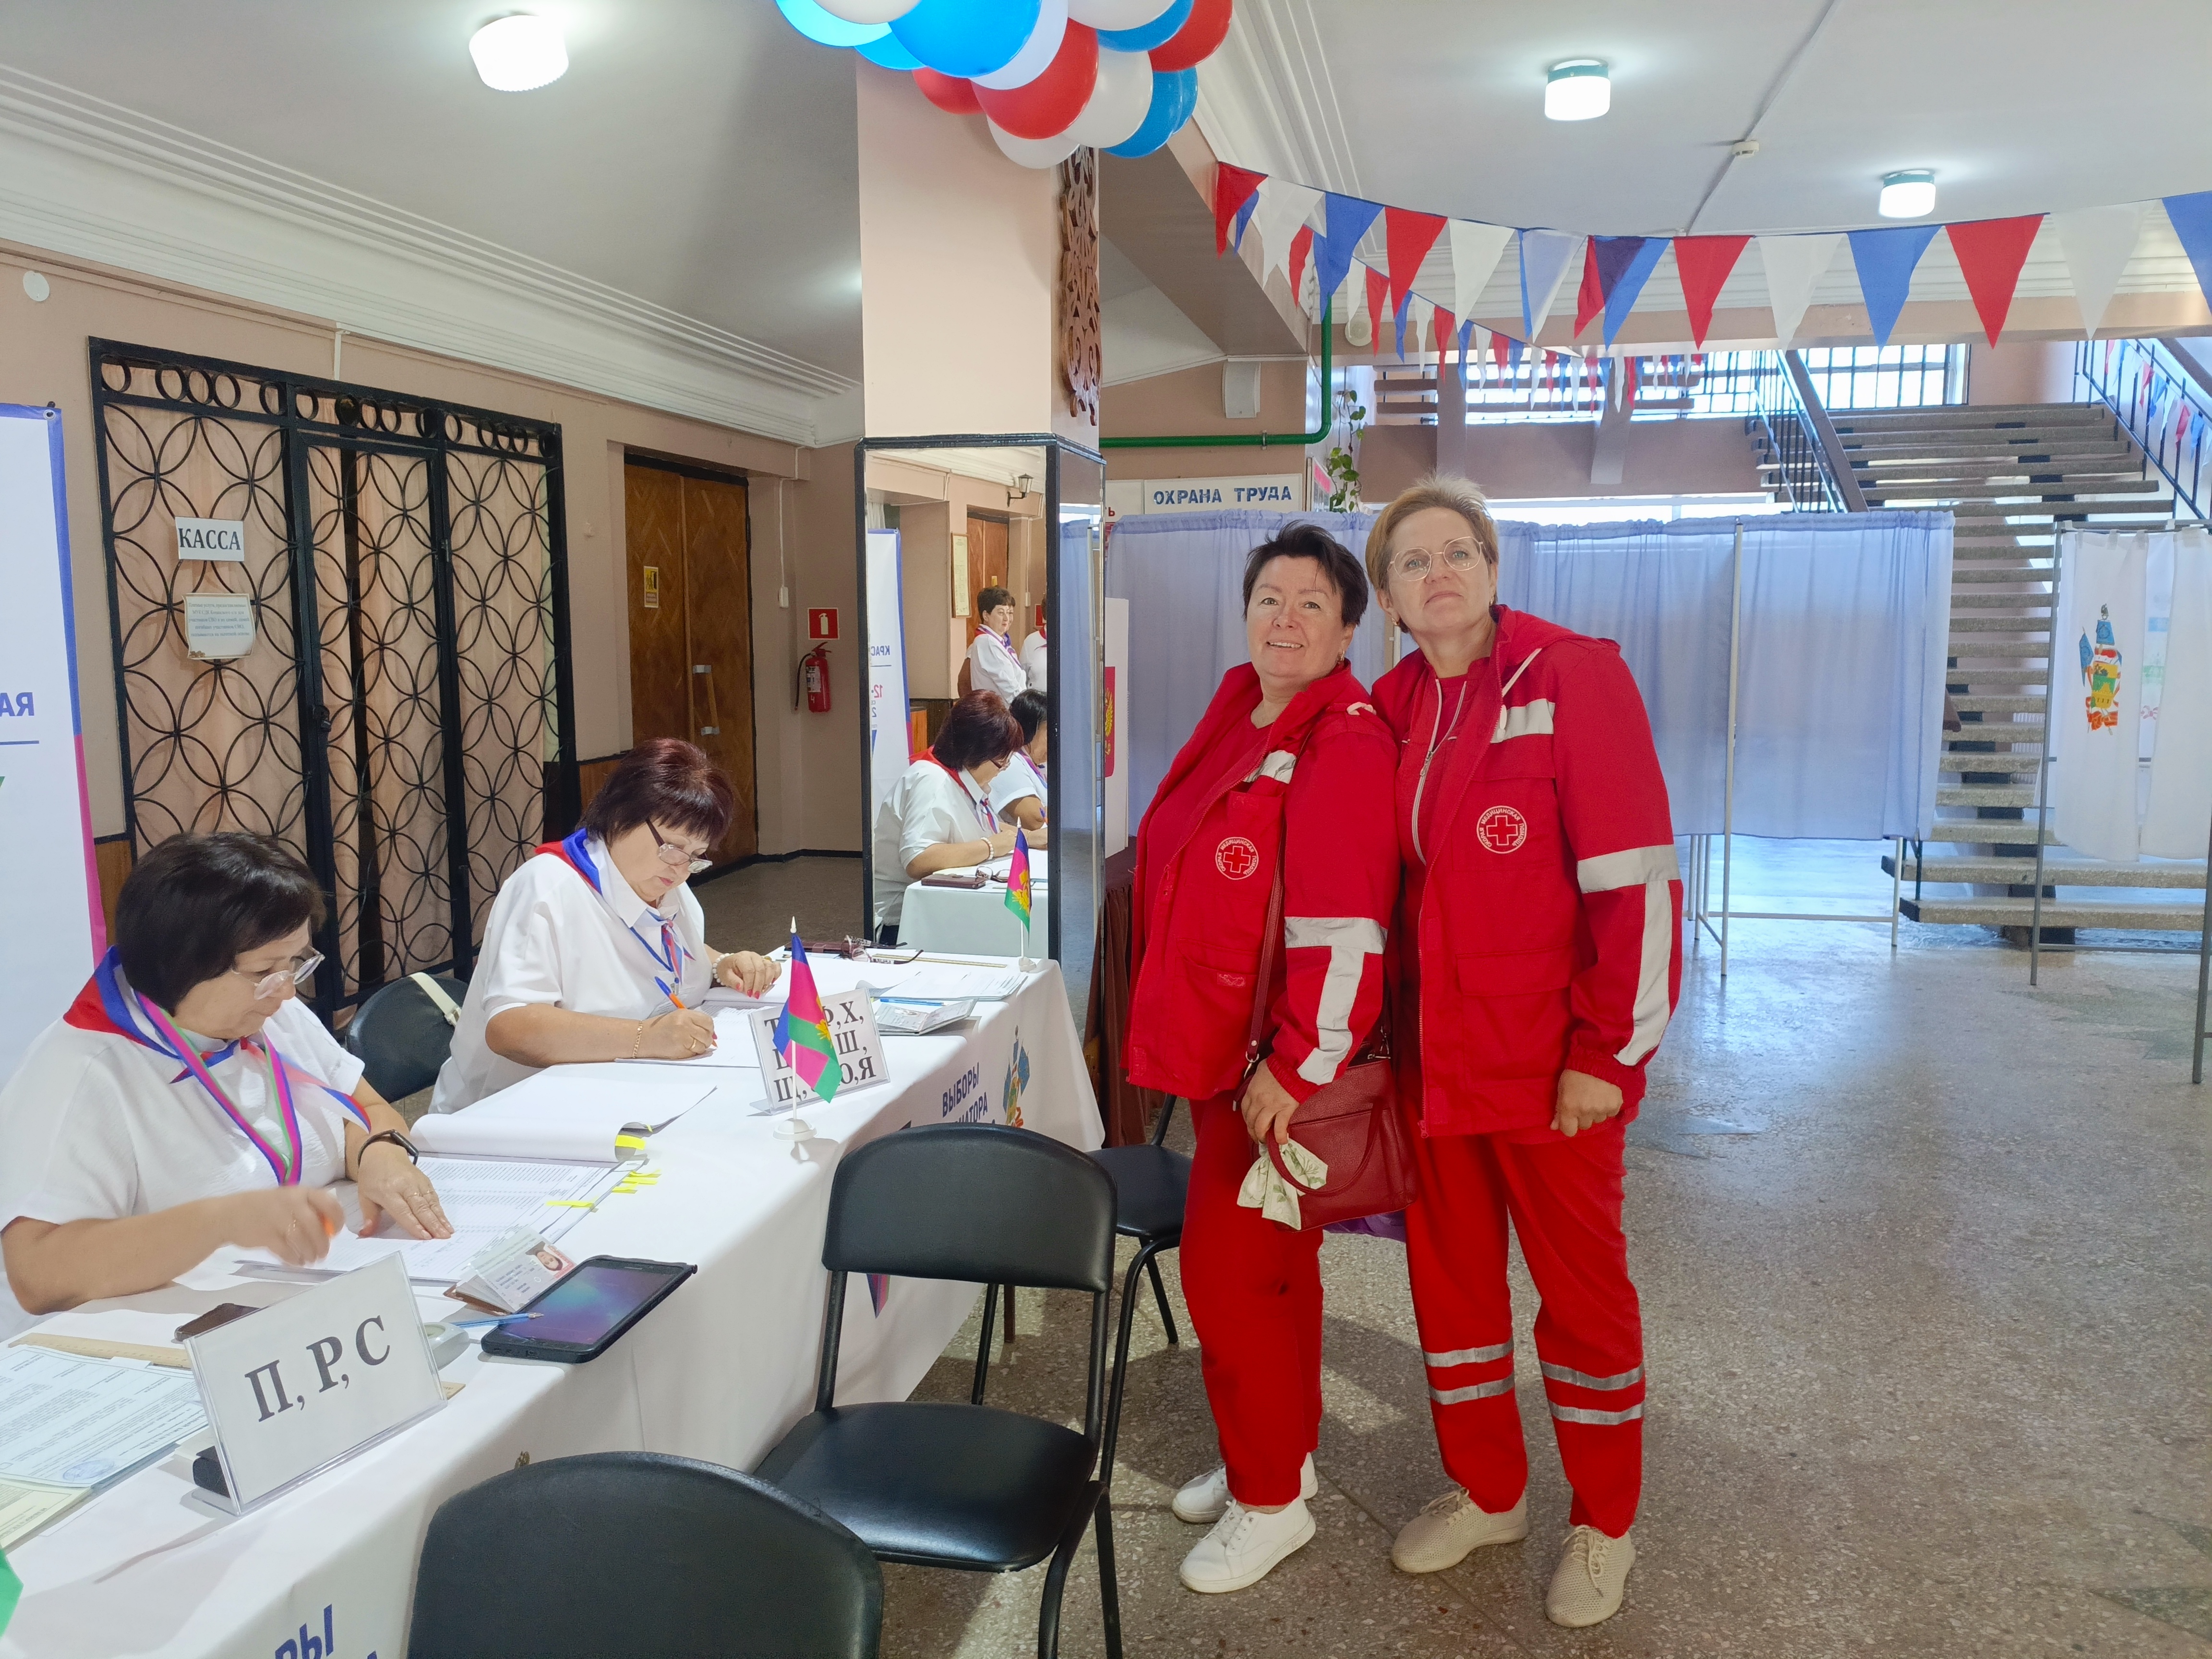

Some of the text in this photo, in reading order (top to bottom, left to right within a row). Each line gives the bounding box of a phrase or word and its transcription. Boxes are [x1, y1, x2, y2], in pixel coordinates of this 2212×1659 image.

[1153, 486, 1292, 505] ОХРАНА ТРУДА
[1105, 506, 1116, 517] Ь
[178, 528, 241, 551] КАССА
[1479, 808, 1525, 847] СКОРАЯ МЕДИЦИНСКАЯ ПОМОЩЬ
[942, 1062, 979, 1118] ВЫБОРЫ
[244, 1359, 305, 1422] П,
[306, 1336, 349, 1393] Р,
[356, 1315, 390, 1366] С
